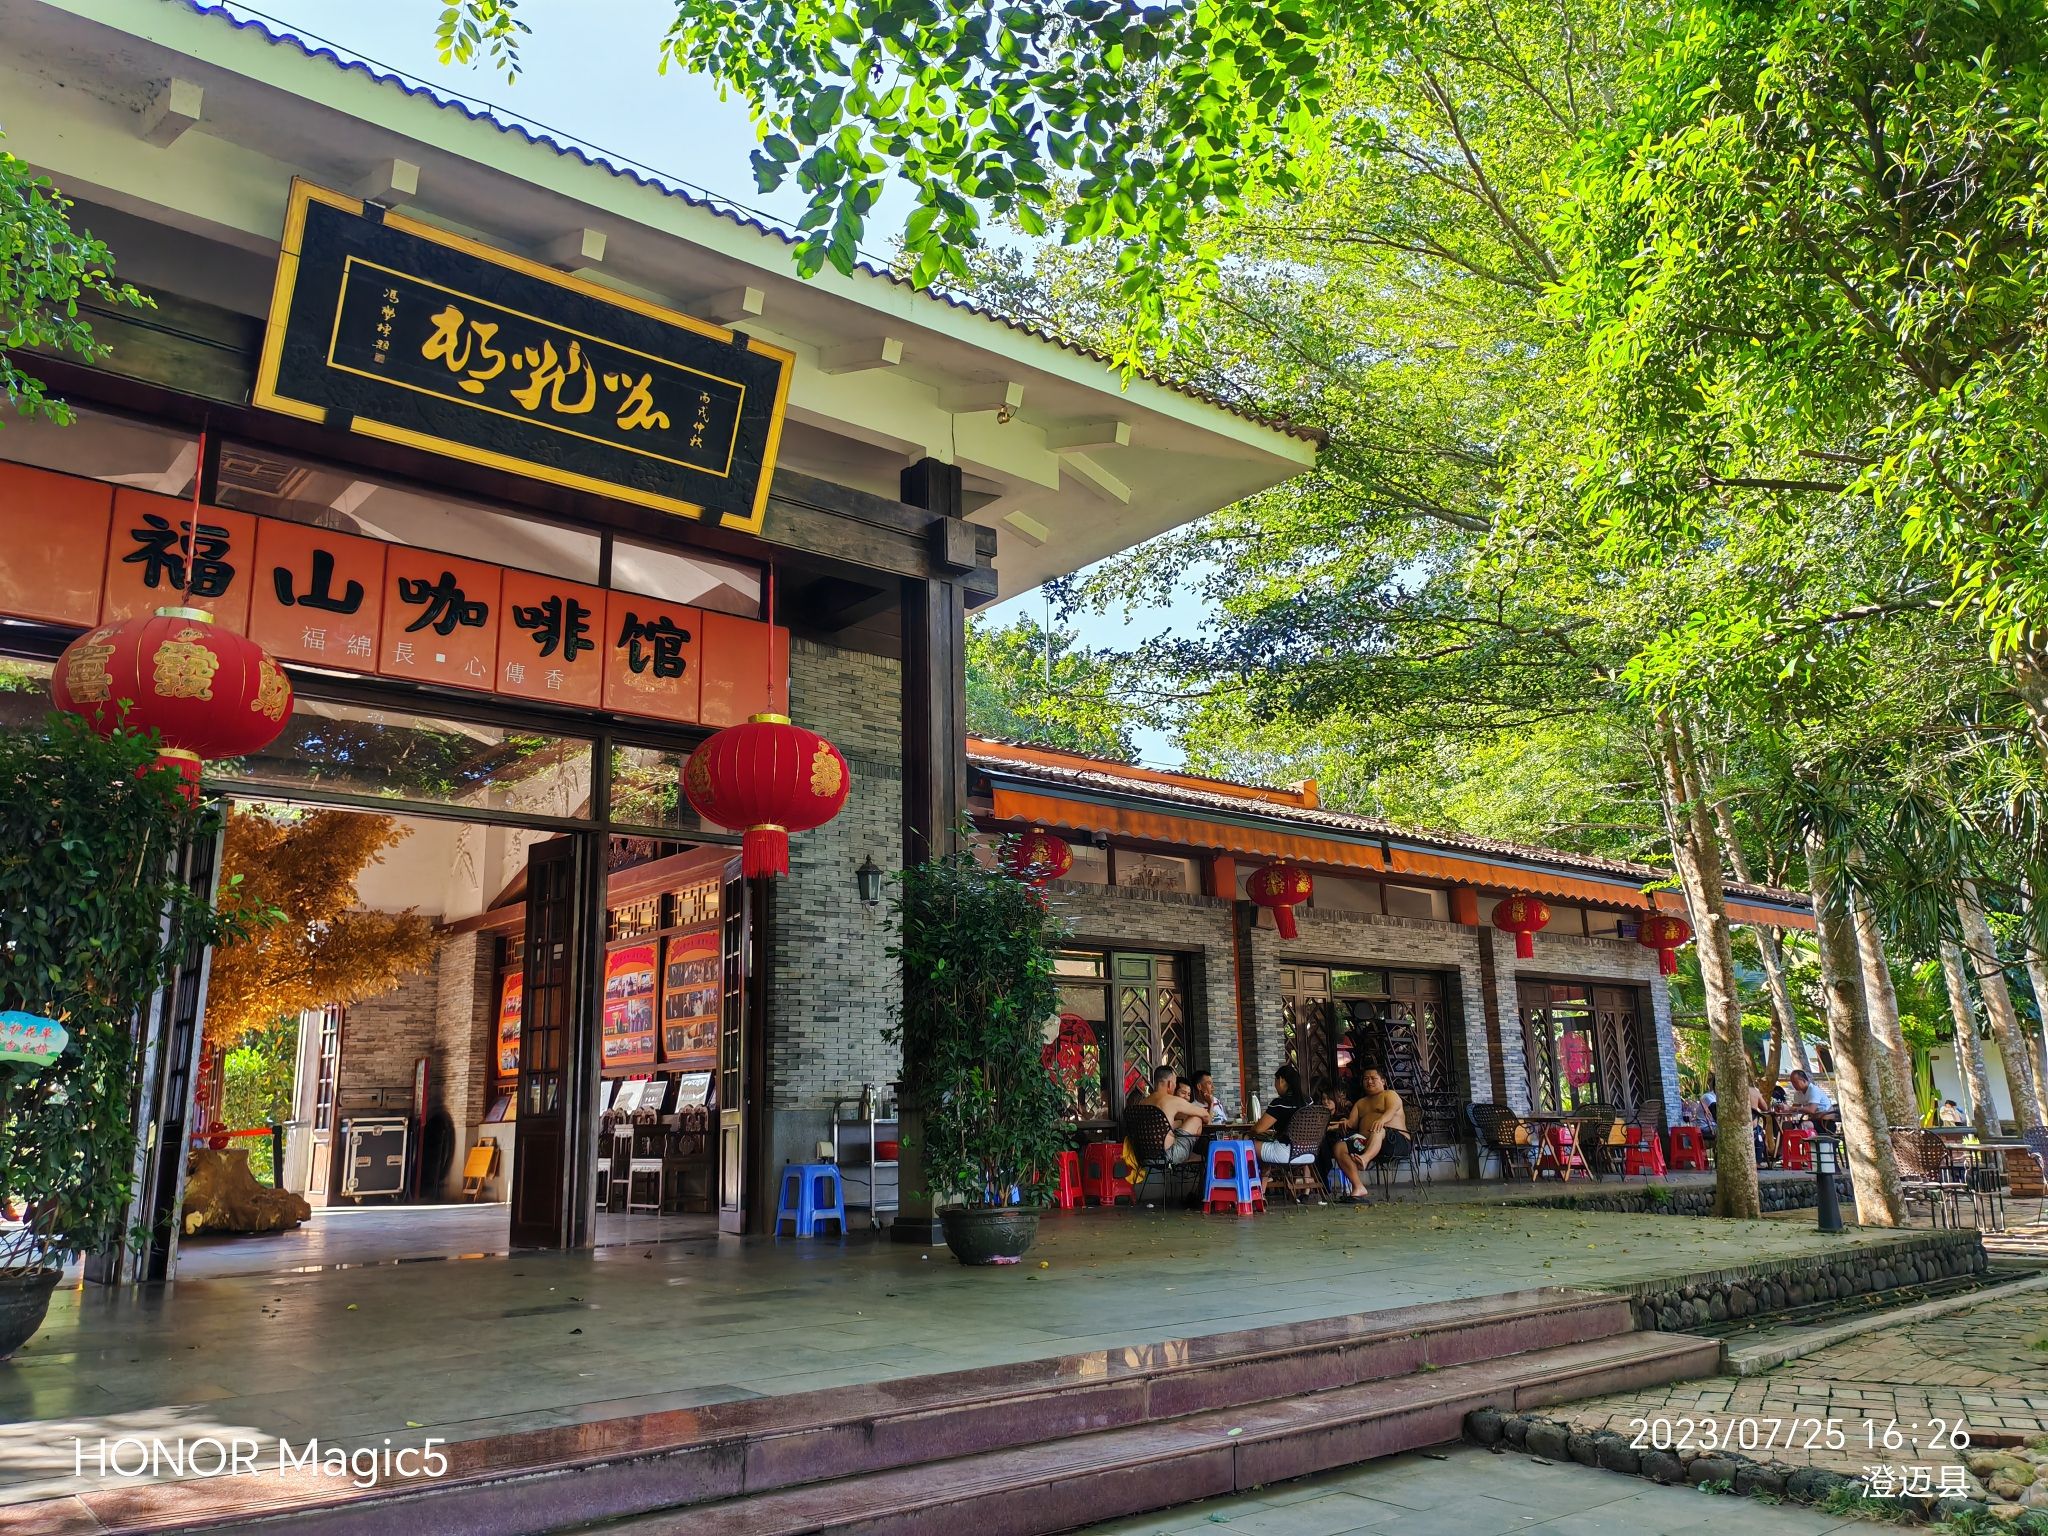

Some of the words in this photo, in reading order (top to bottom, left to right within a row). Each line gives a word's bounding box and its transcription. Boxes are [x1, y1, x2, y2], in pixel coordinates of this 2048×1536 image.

[122, 513, 693, 679] 福山咖啡馆
